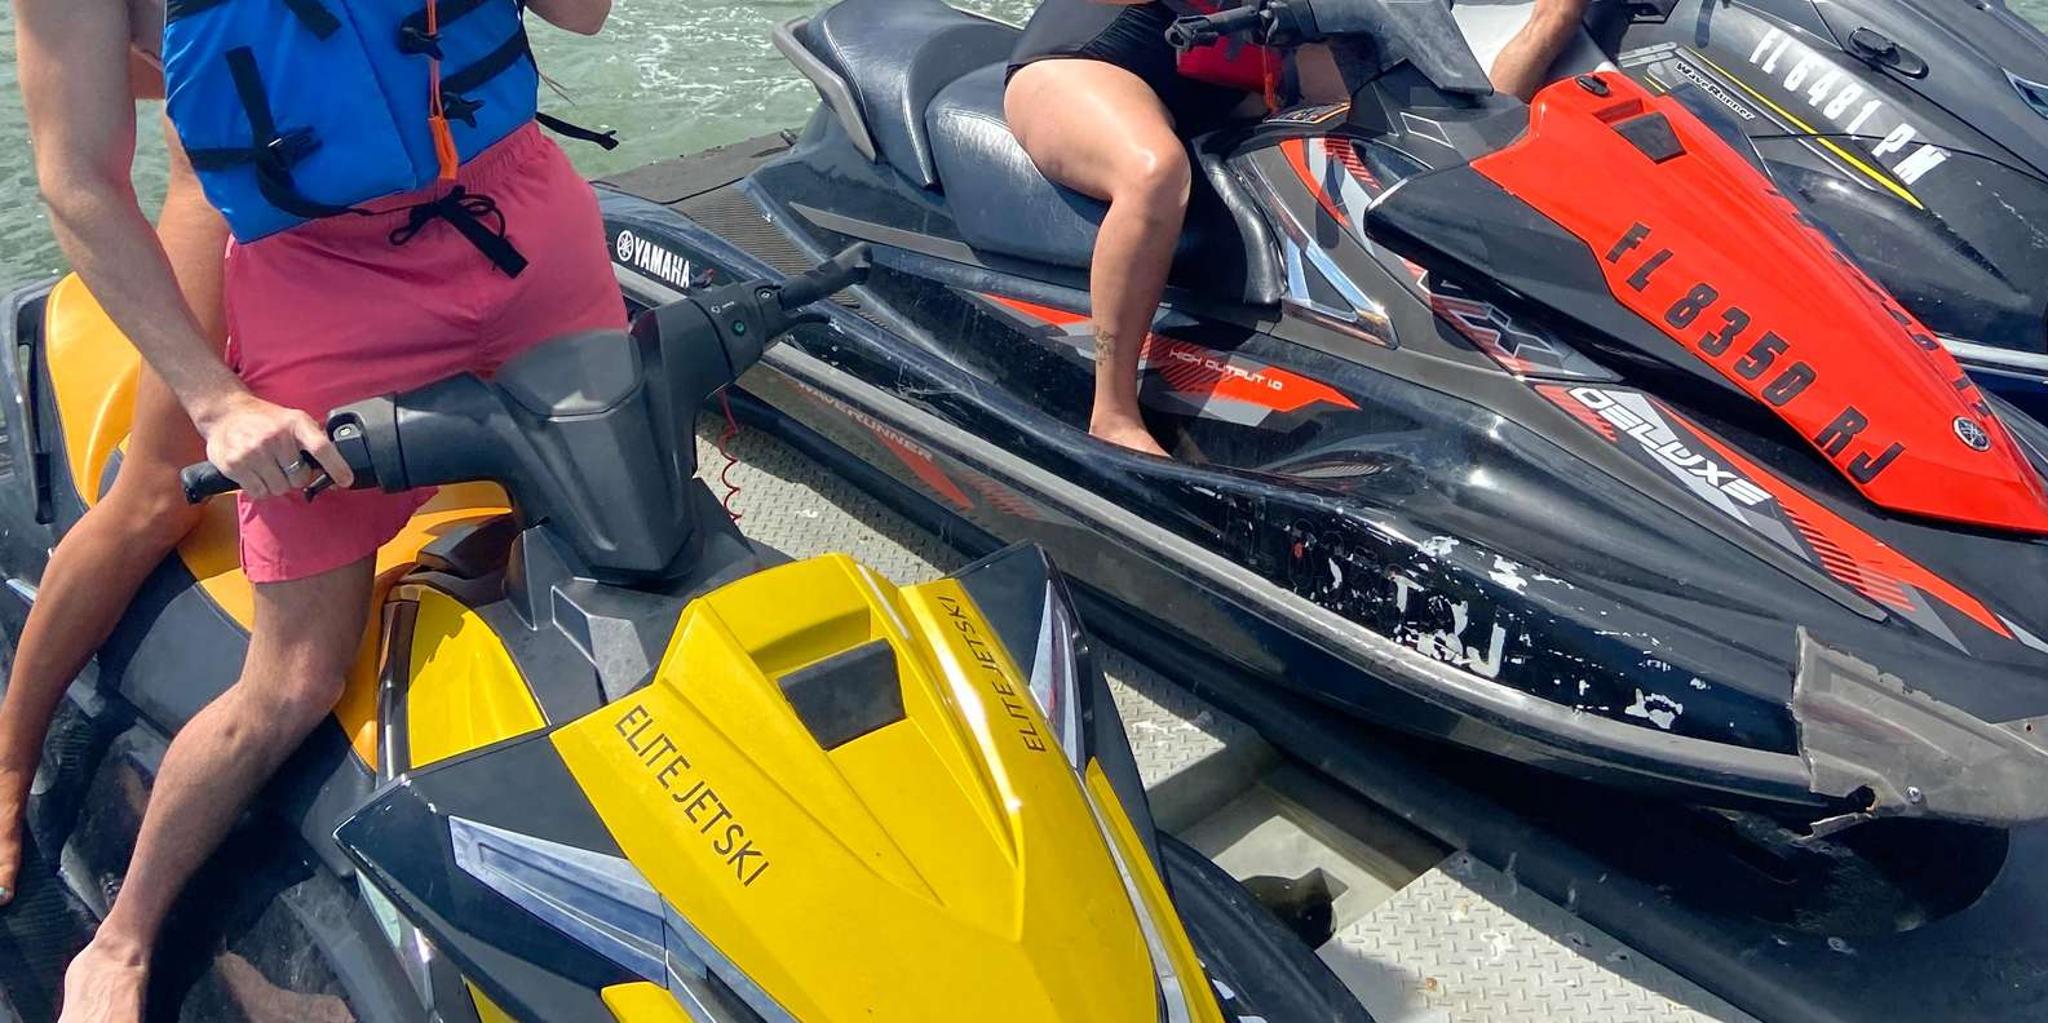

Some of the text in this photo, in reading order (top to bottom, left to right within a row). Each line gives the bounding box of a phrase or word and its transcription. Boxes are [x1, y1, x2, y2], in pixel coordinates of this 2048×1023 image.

[1675, 60, 1755, 121] WaveRunner
[1749, 27, 1796, 75] FL
[1783, 54, 1882, 140] 6481
[634, 236, 692, 289] YAMAHA
[1204, 359, 1266, 384] OUTPUT
[1605, 222, 1905, 484] FL 8350 RJ
[799, 382, 934, 462] WAVERUNNER
[1568, 387, 1774, 506] DELUXE
[936, 596, 1047, 753] ELITE JETSKI
[614, 704, 770, 887] ELITE JETSKI
